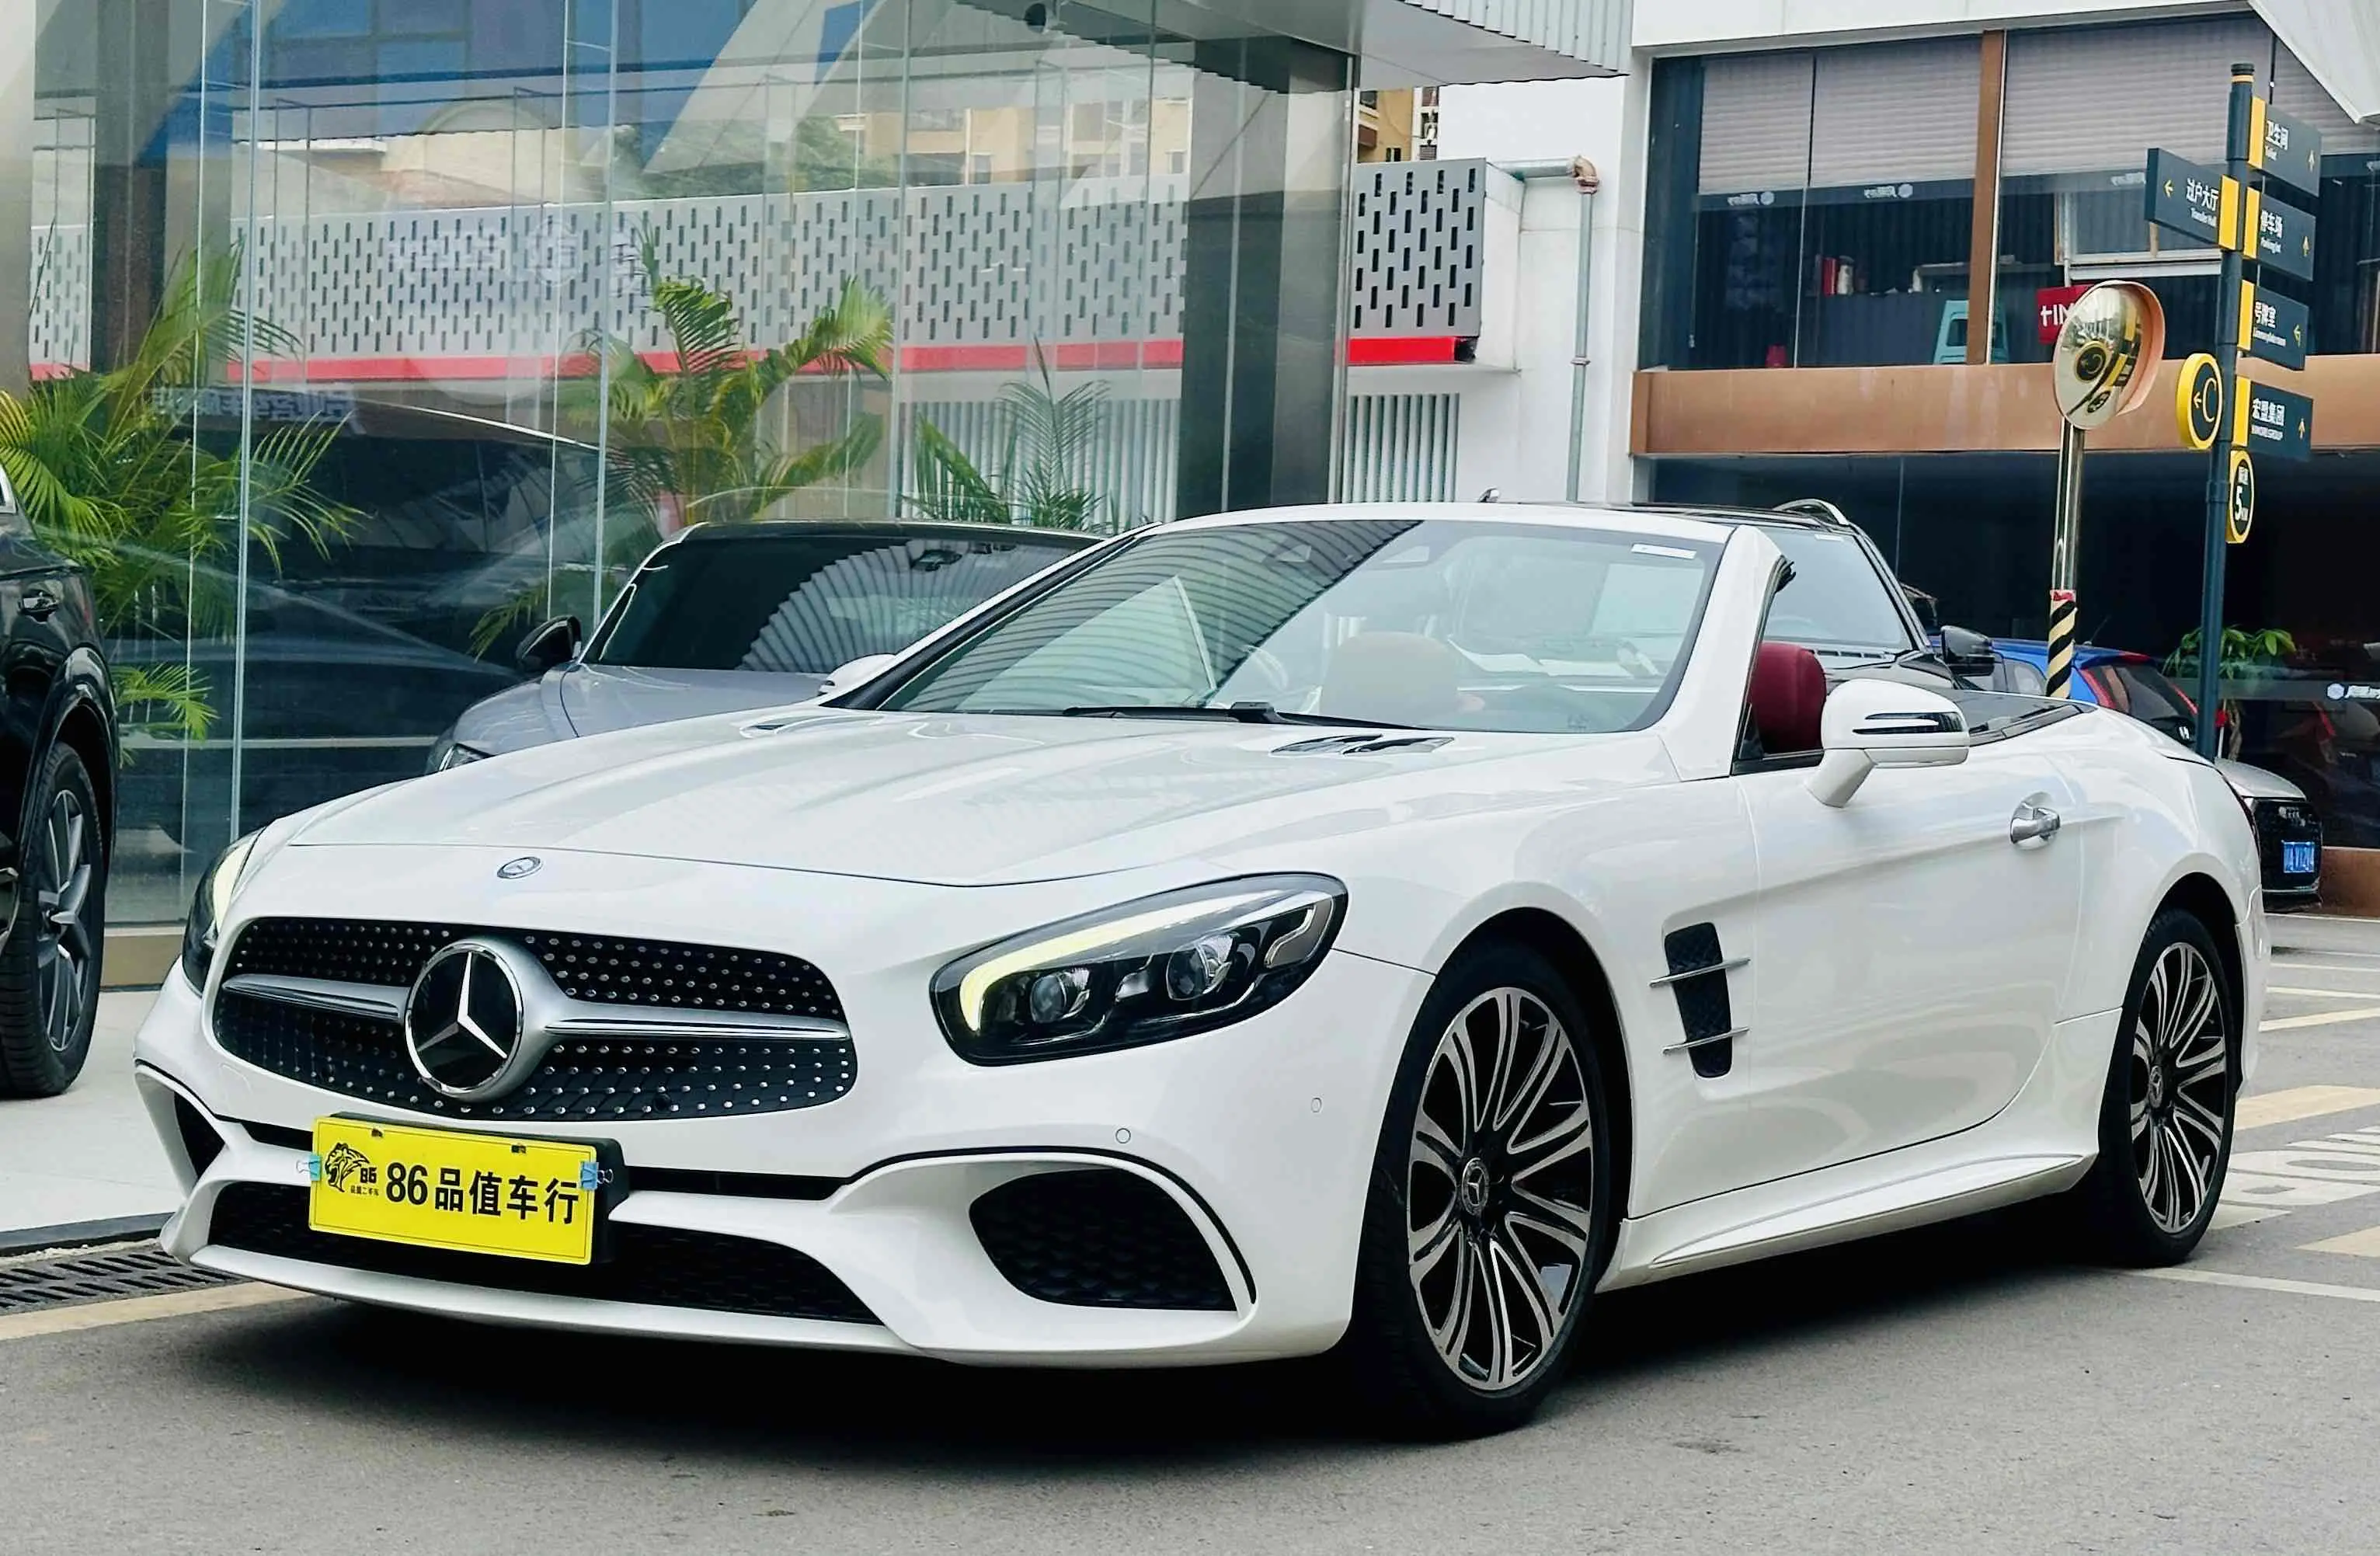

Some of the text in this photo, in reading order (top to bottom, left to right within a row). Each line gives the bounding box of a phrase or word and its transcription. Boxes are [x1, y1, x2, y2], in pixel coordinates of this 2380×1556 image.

[2186, 177, 2219, 211] 过户大厅
[360, 1167, 378, 1183] 86
[386, 1161, 579, 1225] 86品值车行
